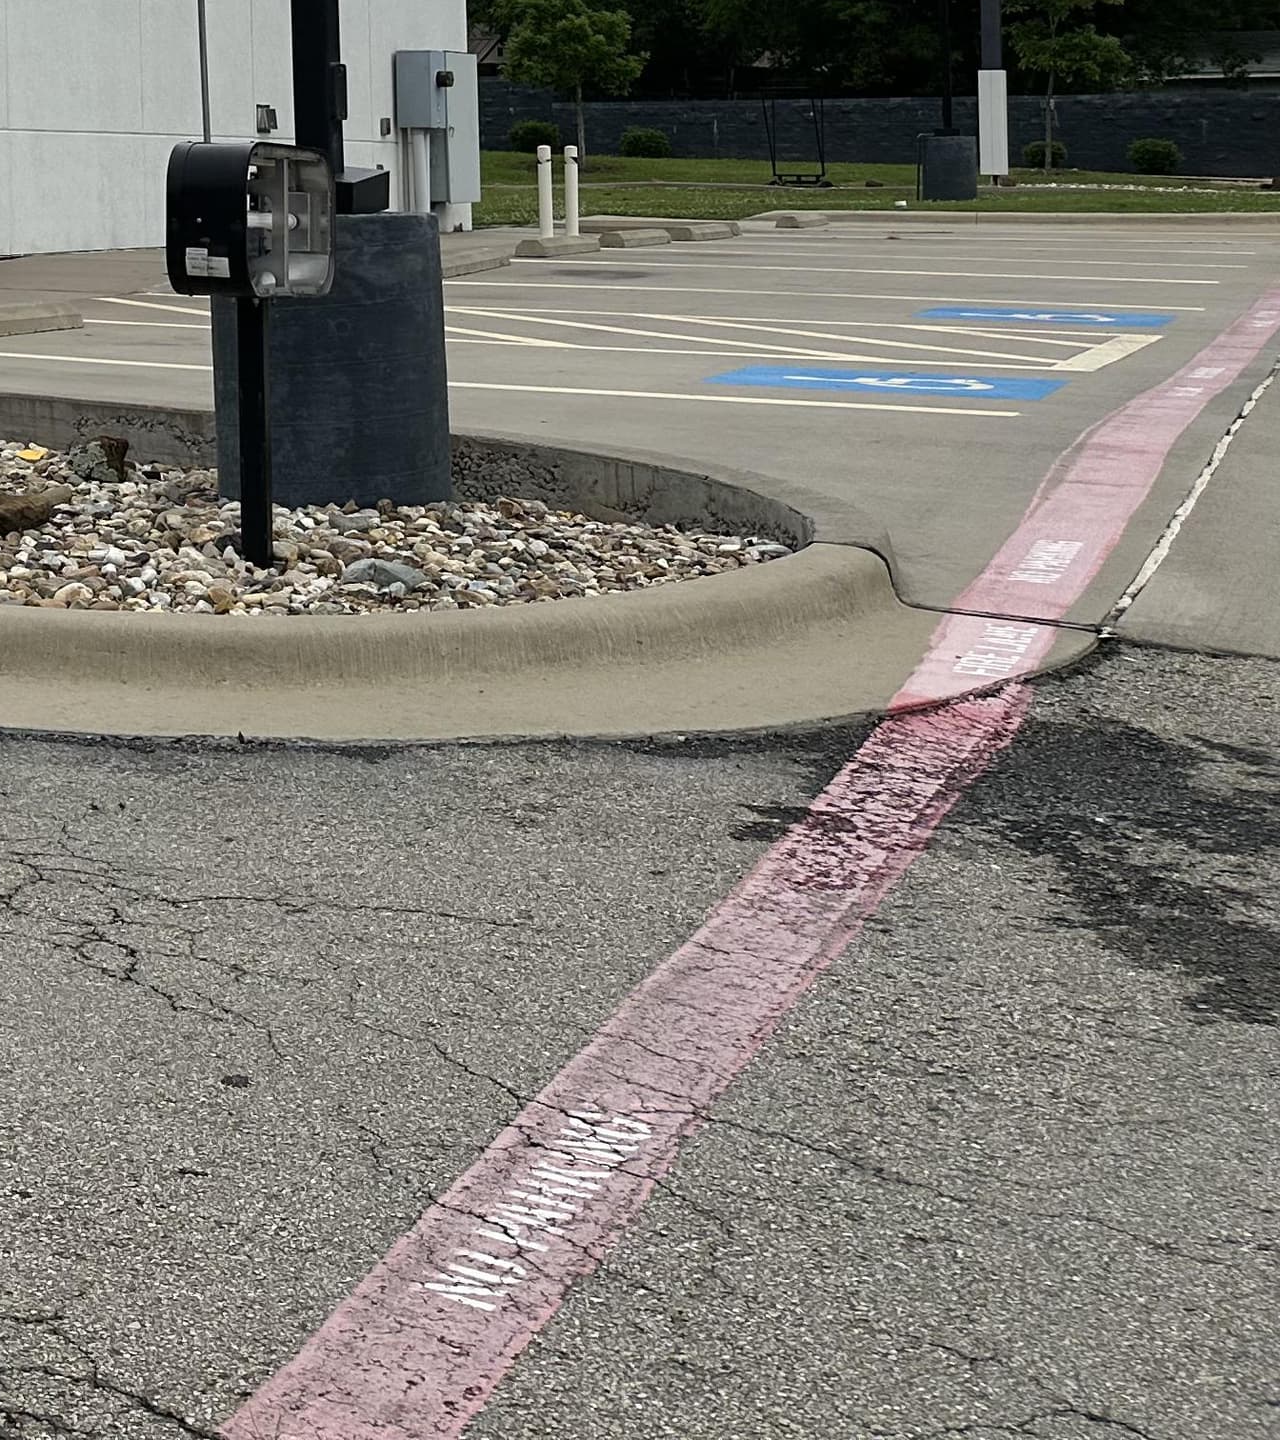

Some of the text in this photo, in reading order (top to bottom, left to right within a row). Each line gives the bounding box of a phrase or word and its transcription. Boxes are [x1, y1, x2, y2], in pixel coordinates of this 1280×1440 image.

[951, 623, 1039, 678] FIRE LANE
[412, 1109, 652, 1312] NO PARKING
